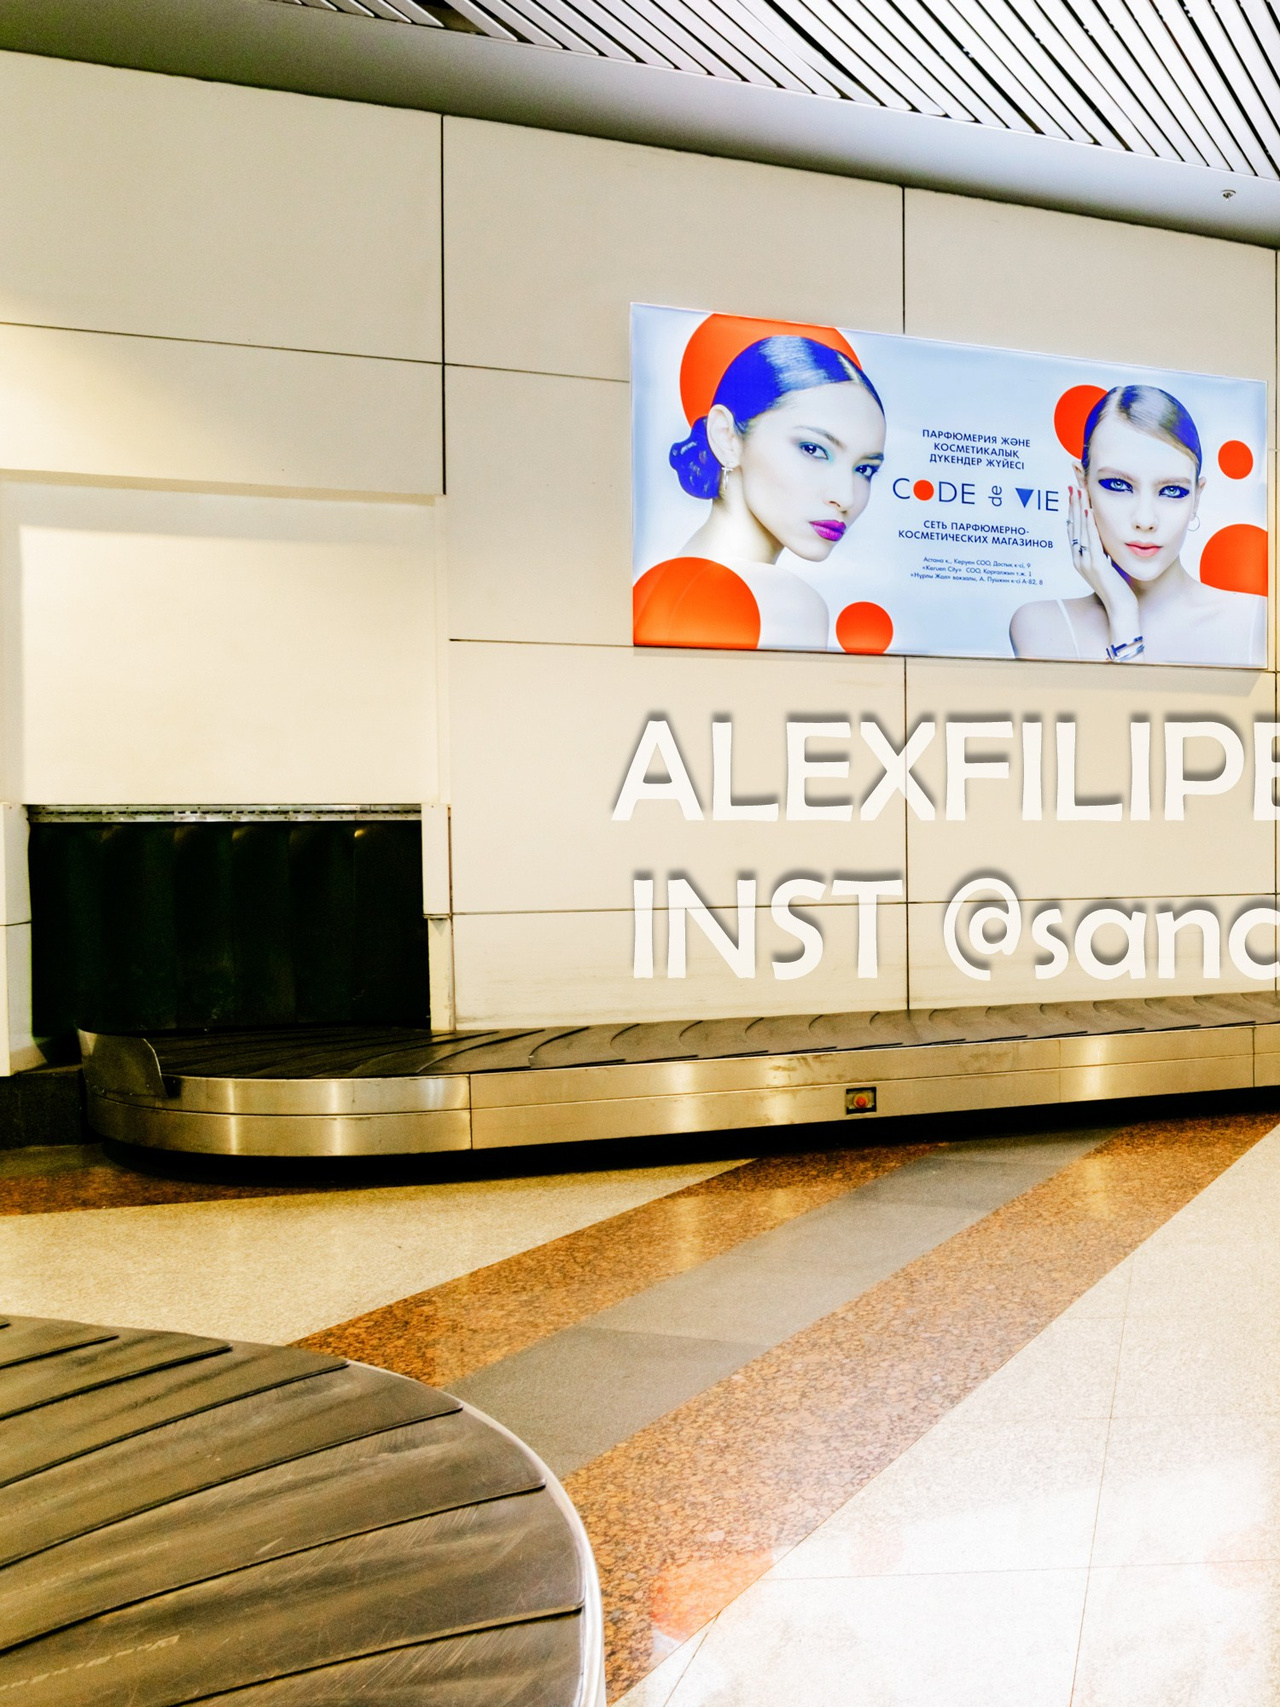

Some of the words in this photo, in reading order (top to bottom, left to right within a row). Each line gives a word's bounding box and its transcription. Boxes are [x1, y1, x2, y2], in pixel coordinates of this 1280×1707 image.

[922, 429, 998, 444] ПАРФЮМЕРИЯ
[1000, 436, 1031, 448] ЖӘНЕ
[933, 442, 1020, 459] КОСМЕТИКАЛЫҚ
[929, 453, 983, 467] ДҮКЕНДЕР
[985, 458, 1025, 470] ЖҮЙЕСІ
[987, 485, 1003, 507] de
[923, 519, 948, 530] СЕТЬ
[950, 522, 1030, 536] ПАРФЮМЕРНО-
[898, 529, 989, 544] КОСМЕТИЧЕСКИХ
[991, 536, 1054, 549] МАГАЗИНОВ
